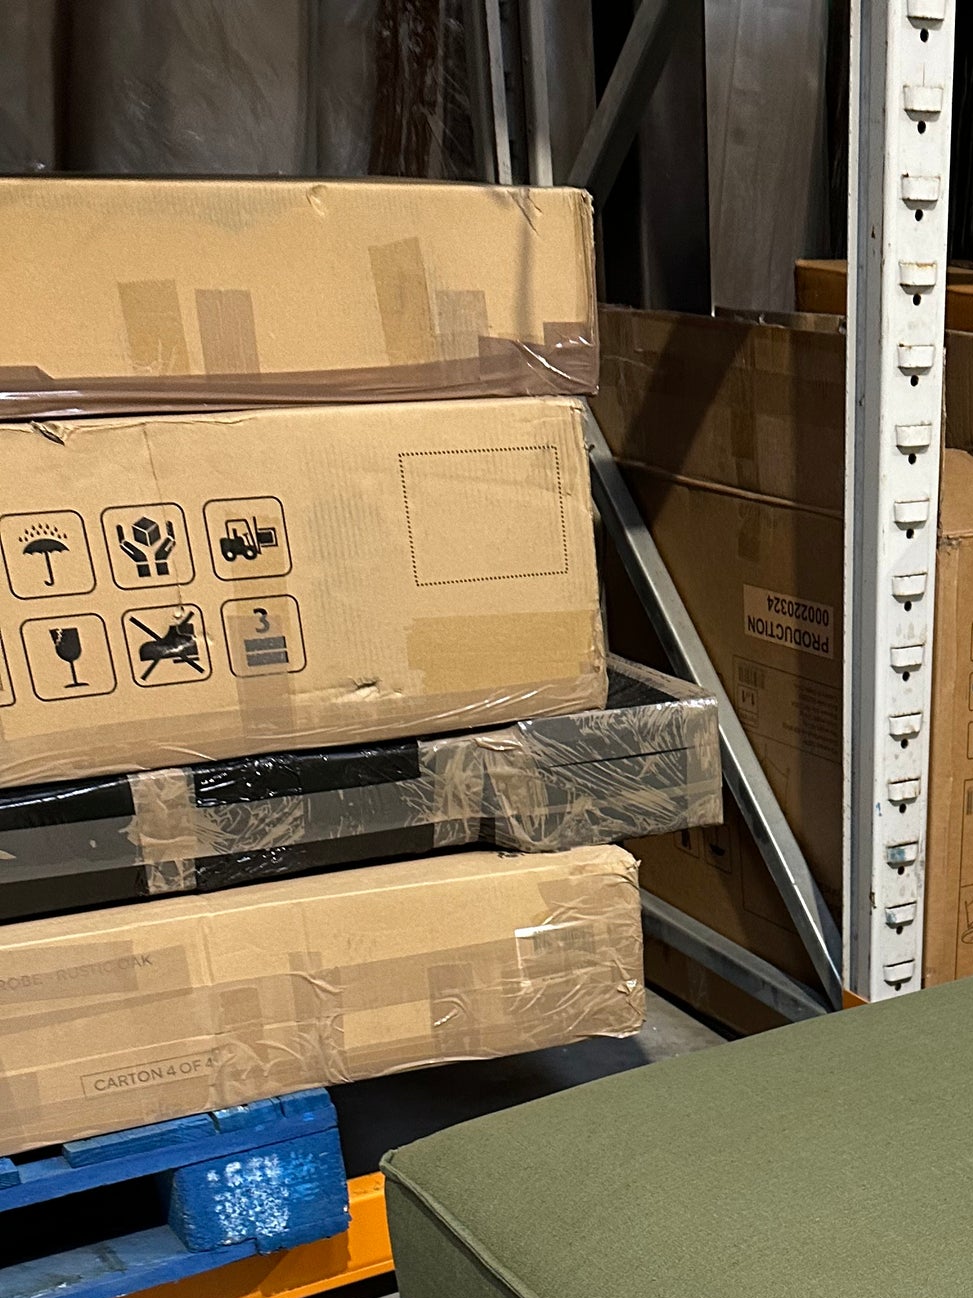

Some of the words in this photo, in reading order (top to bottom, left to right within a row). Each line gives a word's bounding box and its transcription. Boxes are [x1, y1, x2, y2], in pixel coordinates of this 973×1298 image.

[253, 607, 270, 634] 3
[766, 594, 829, 627] 000220324
[747, 615, 829, 654] PRODUCTION
[56, 961, 112, 982] RUSTIC
[118, 953, 153, 971] OAK
[94, 1064, 164, 1092] CARTON
[163, 1065, 176, 1077] 4
[179, 1059, 202, 1075] OF
